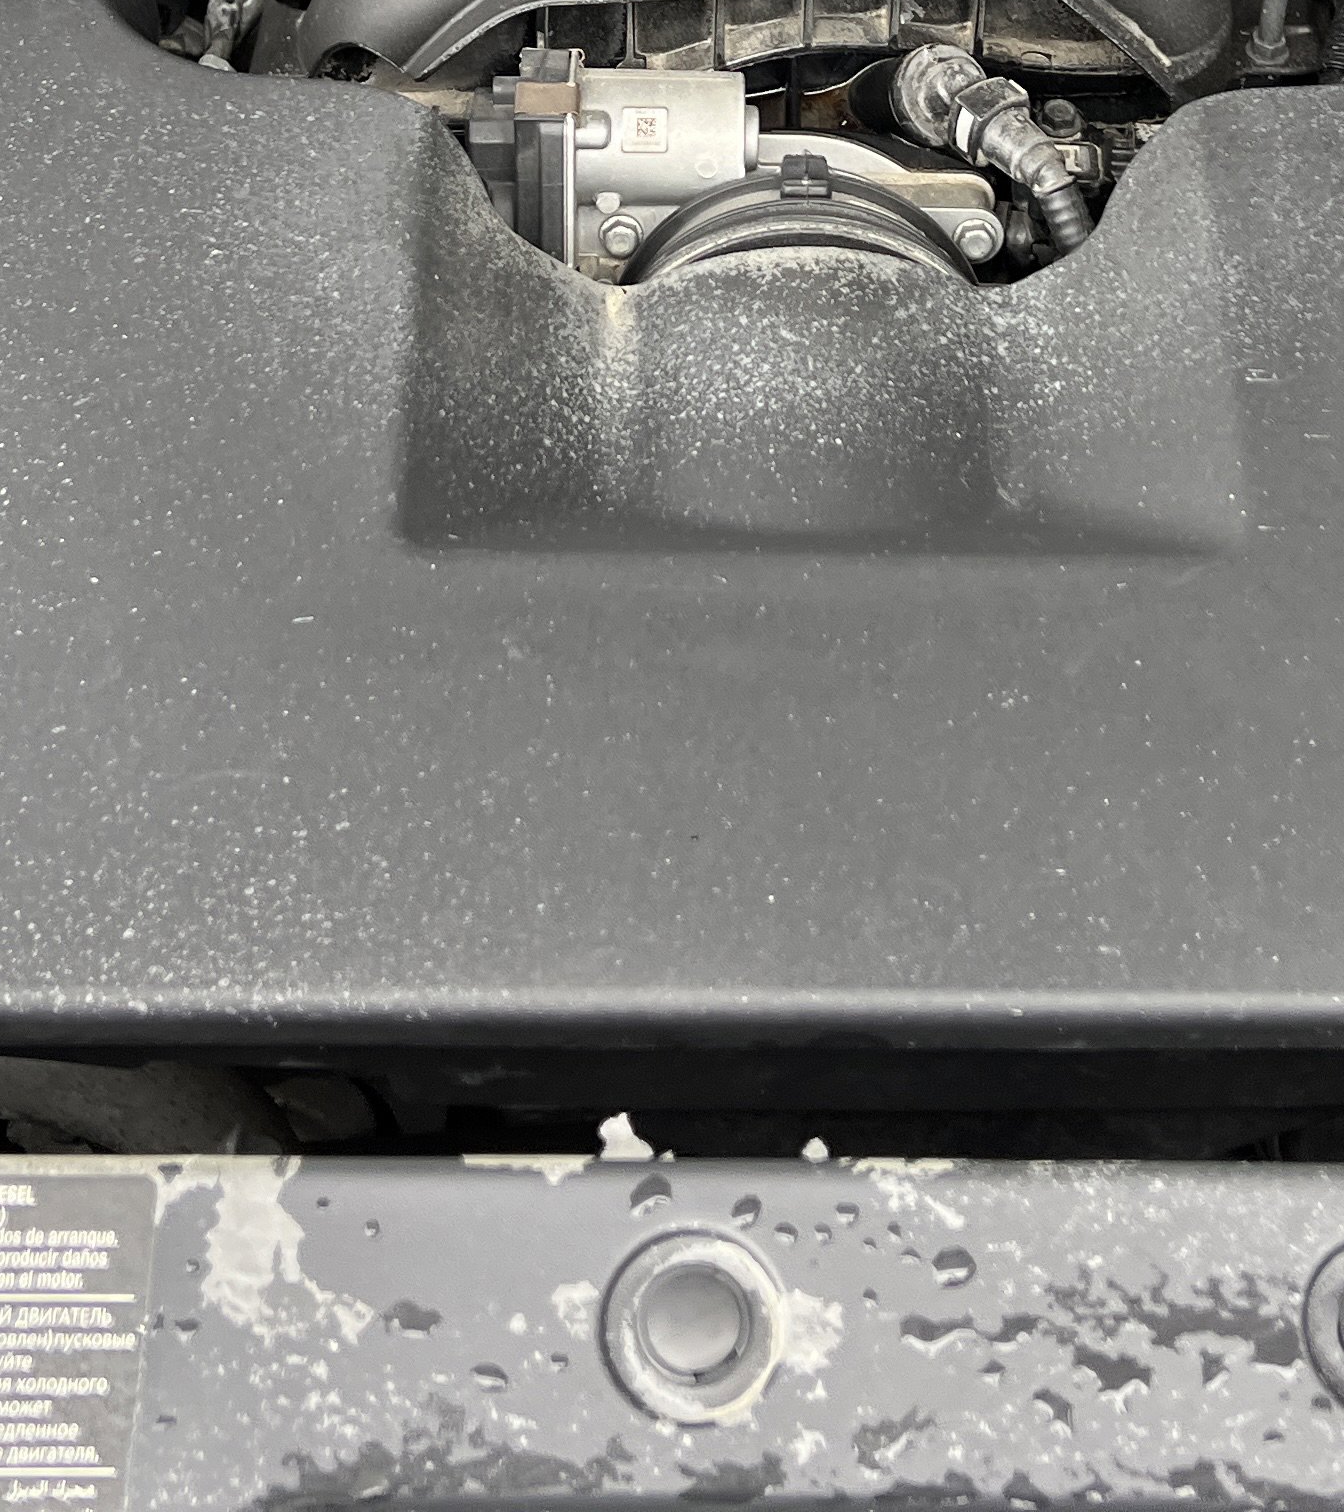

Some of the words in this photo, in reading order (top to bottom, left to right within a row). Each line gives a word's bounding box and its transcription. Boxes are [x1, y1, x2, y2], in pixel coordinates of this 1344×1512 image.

[25, 1229, 44, 1246] de
[61, 1249, 109, 1268] daños
[19, 1271, 33, 1288] el
[15, 1307, 113, 1328] ДВИГАТЕЛЬ
[16, 1378, 109, 1396] холодного
